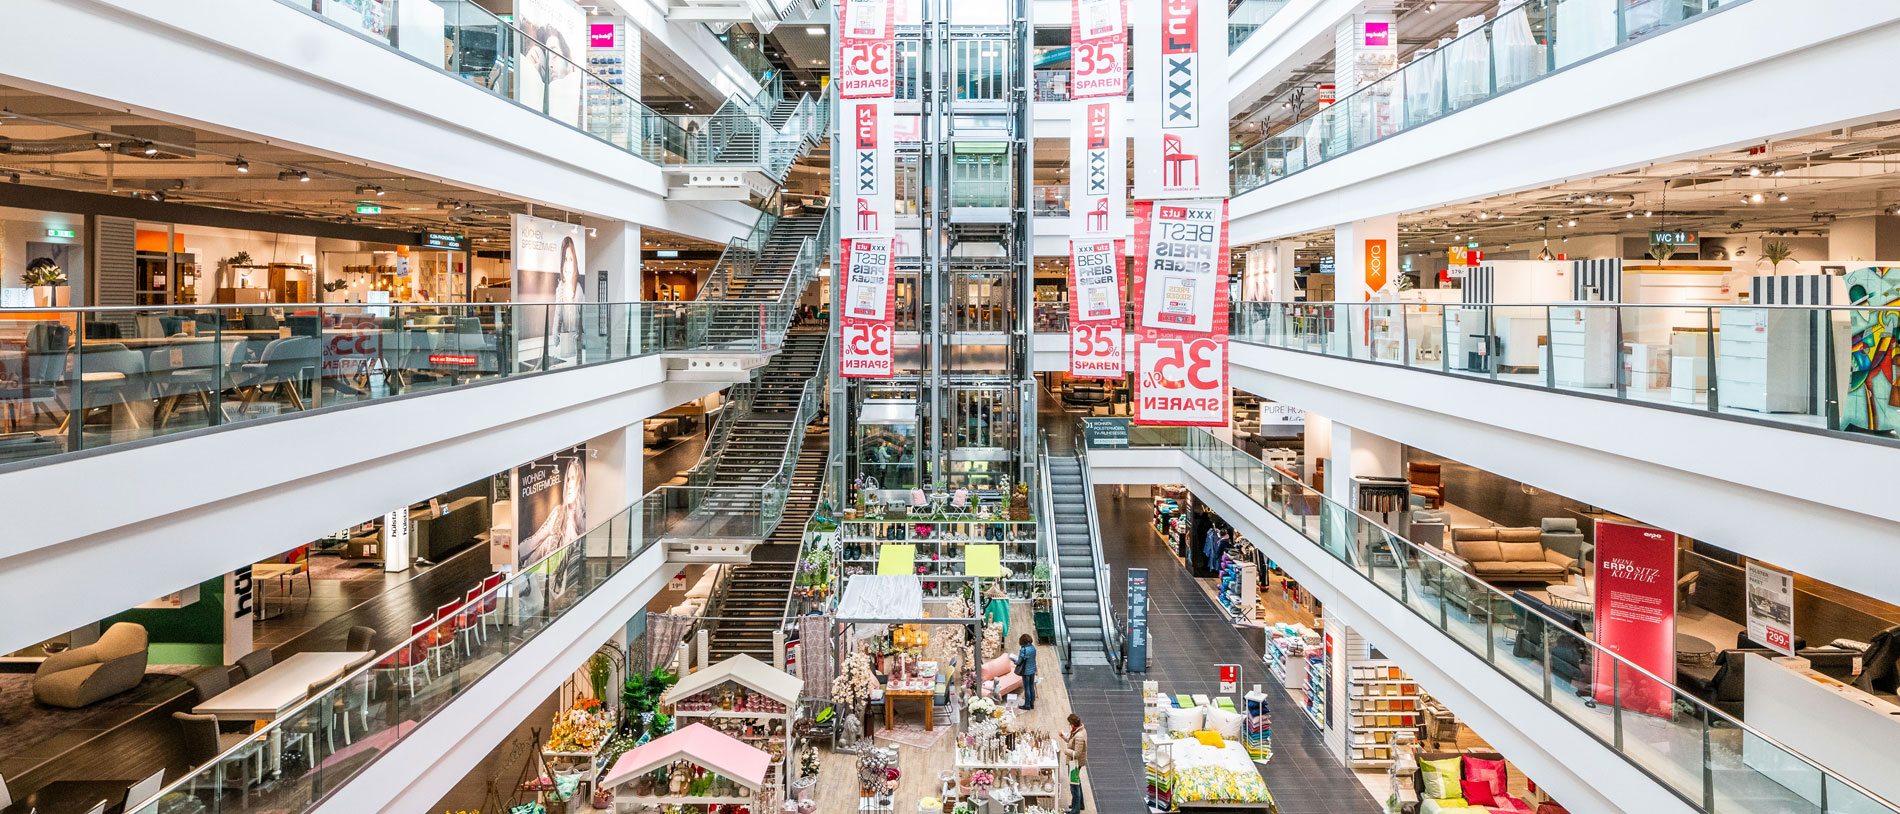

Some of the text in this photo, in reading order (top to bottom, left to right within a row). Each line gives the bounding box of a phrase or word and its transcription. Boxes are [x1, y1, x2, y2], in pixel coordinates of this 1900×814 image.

[1076, 42, 1122, 76] 35%
[1076, 78, 1120, 89] SPAREN
[1656, 234, 1672, 242] WC
[1078, 253, 1110, 266] BEST
[1371, 245, 1380, 276] xora
[1080, 266, 1112, 277] PREIS
[1080, 276, 1114, 286] SIEGER
[1075, 325, 1120, 357] 35%
[1075, 360, 1119, 370] SPAREN
[522, 469, 546, 486] WOHNEN
[522, 475, 561, 498] POLSTERMÖBEL
[1604, 561, 1634, 572] ERPO
[1749, 567, 1768, 577] POLSTER
